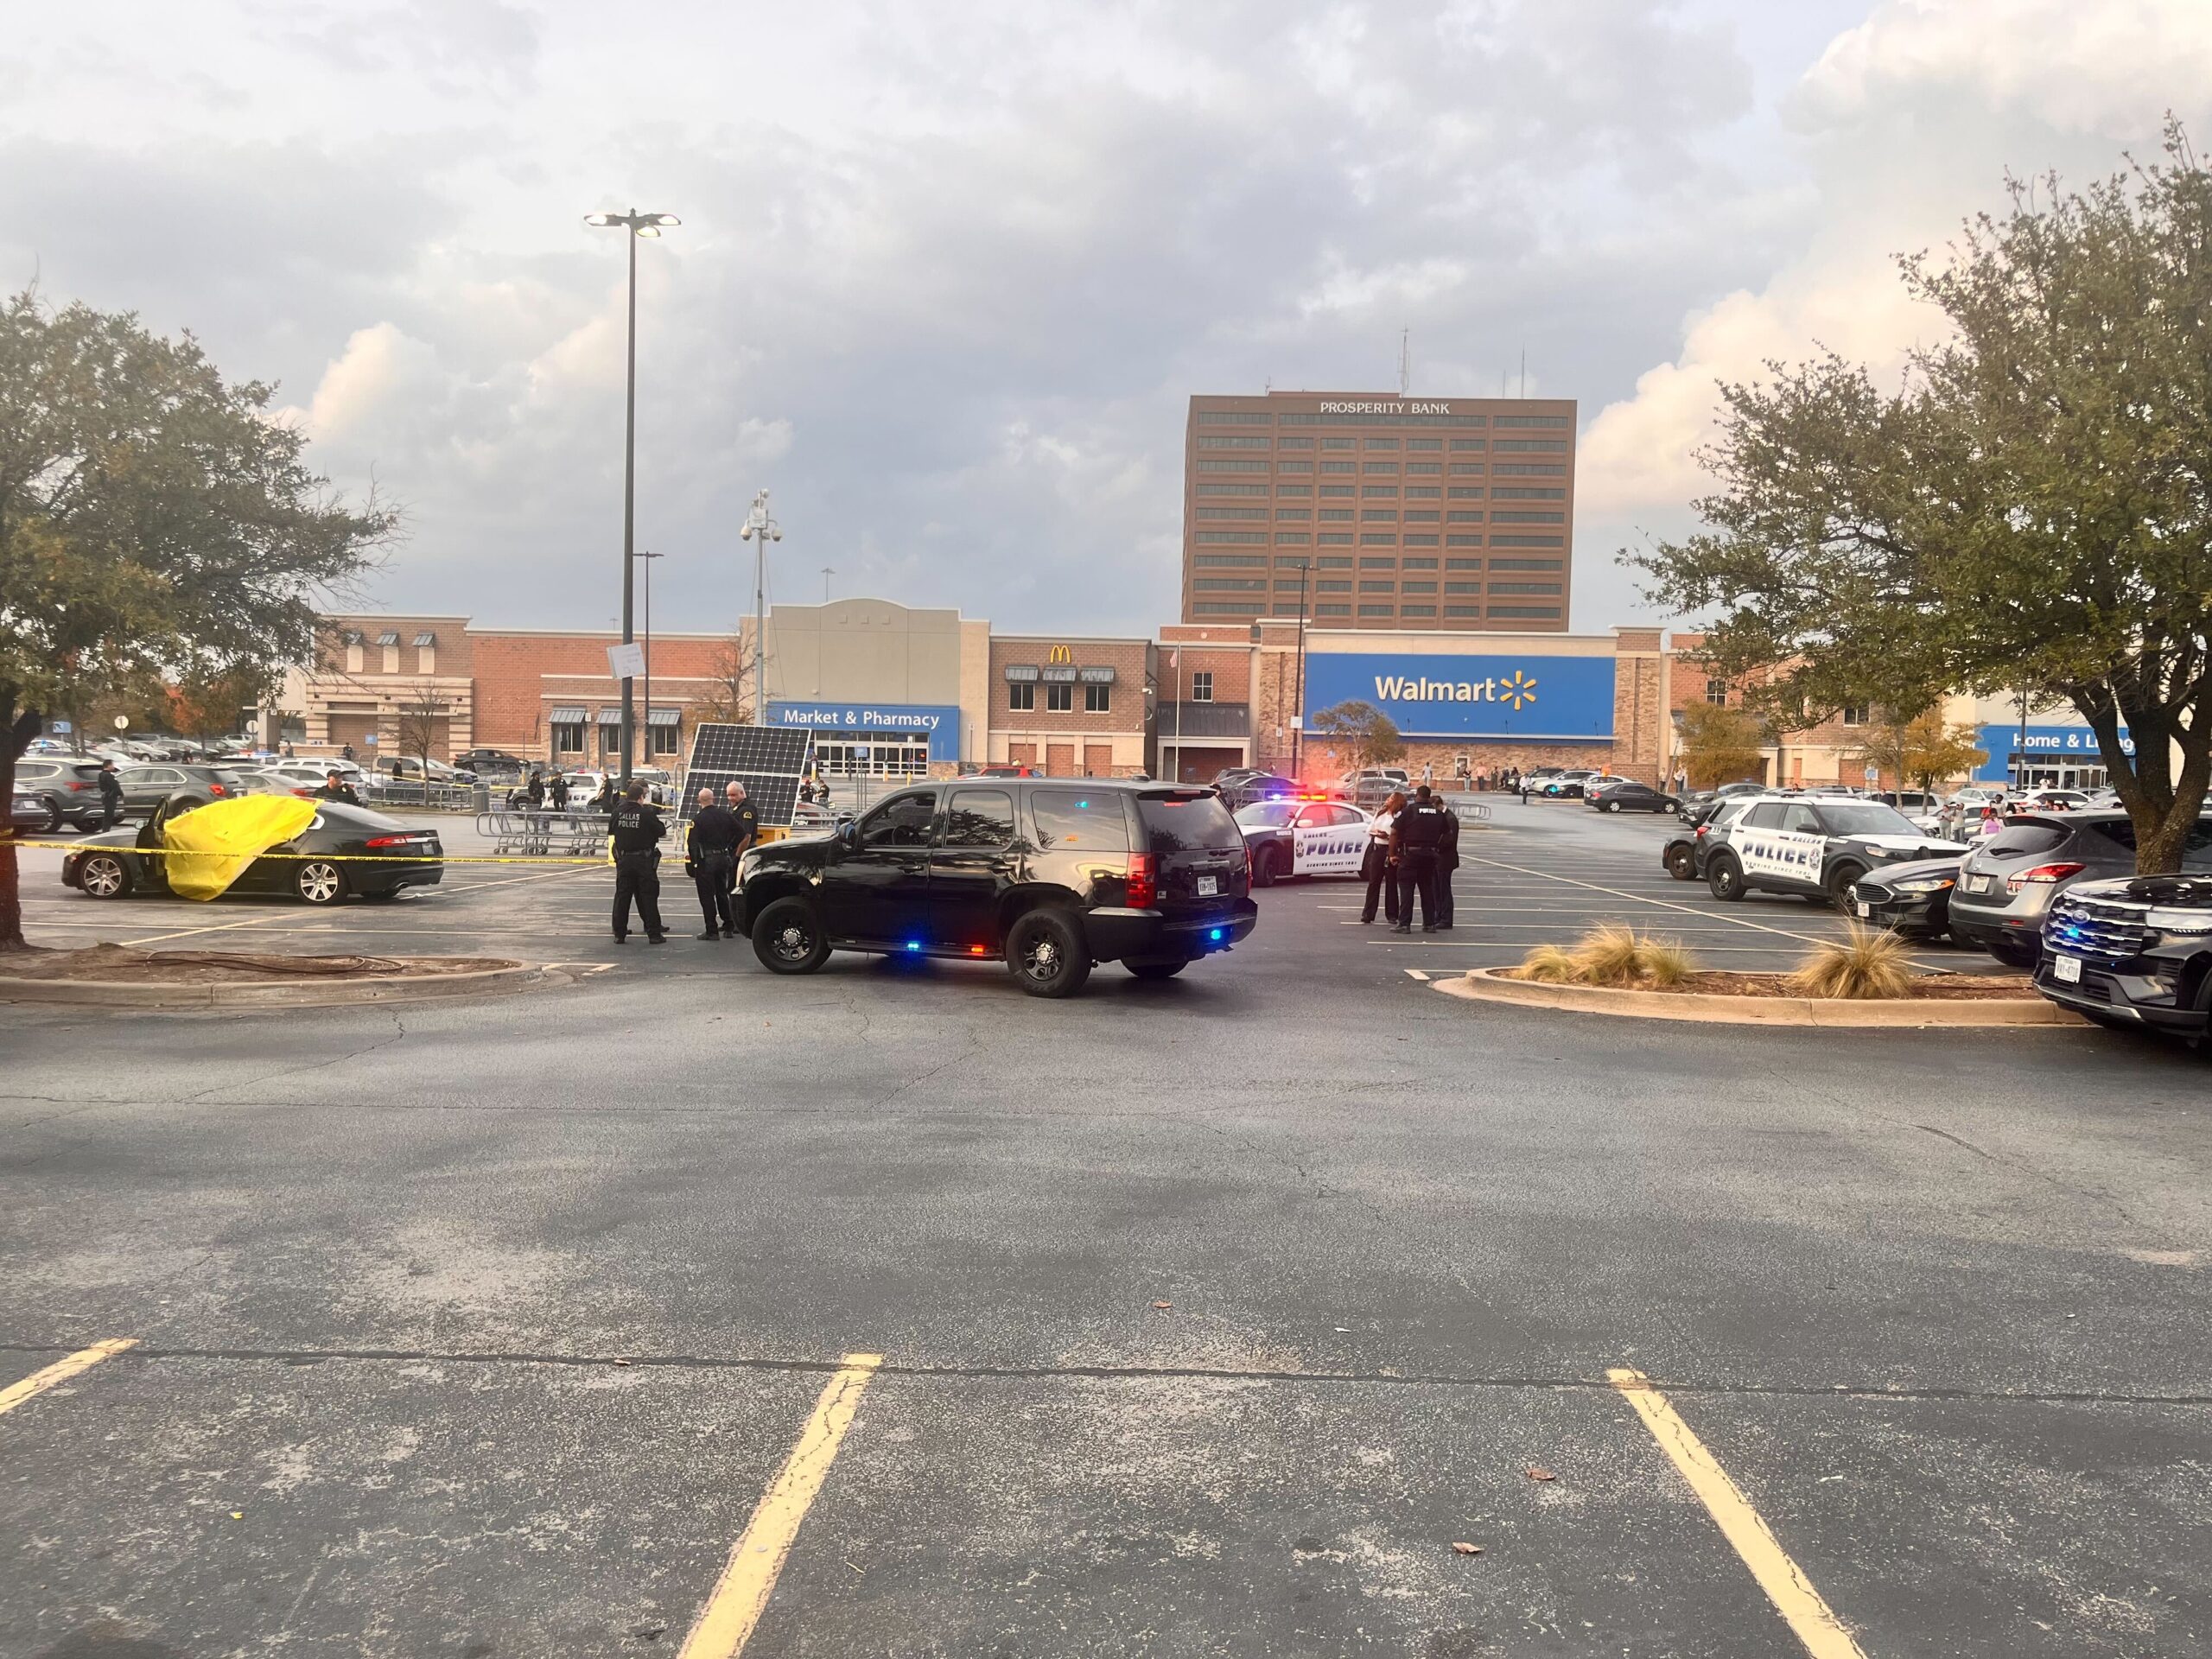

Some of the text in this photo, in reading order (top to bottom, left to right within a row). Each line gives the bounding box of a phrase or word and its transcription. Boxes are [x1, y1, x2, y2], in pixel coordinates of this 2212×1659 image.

[1320, 402, 1450, 414] PROSPERITY BANK
[1375, 677, 1496, 702] Walmart
[785, 710, 940, 729] Market & Pharmacy
[2013, 733, 2060, 747] Home
[2067, 734, 2079, 748] &
[1306, 841, 1363, 855] POLICE
[1742, 841, 1808, 866] POLICE
